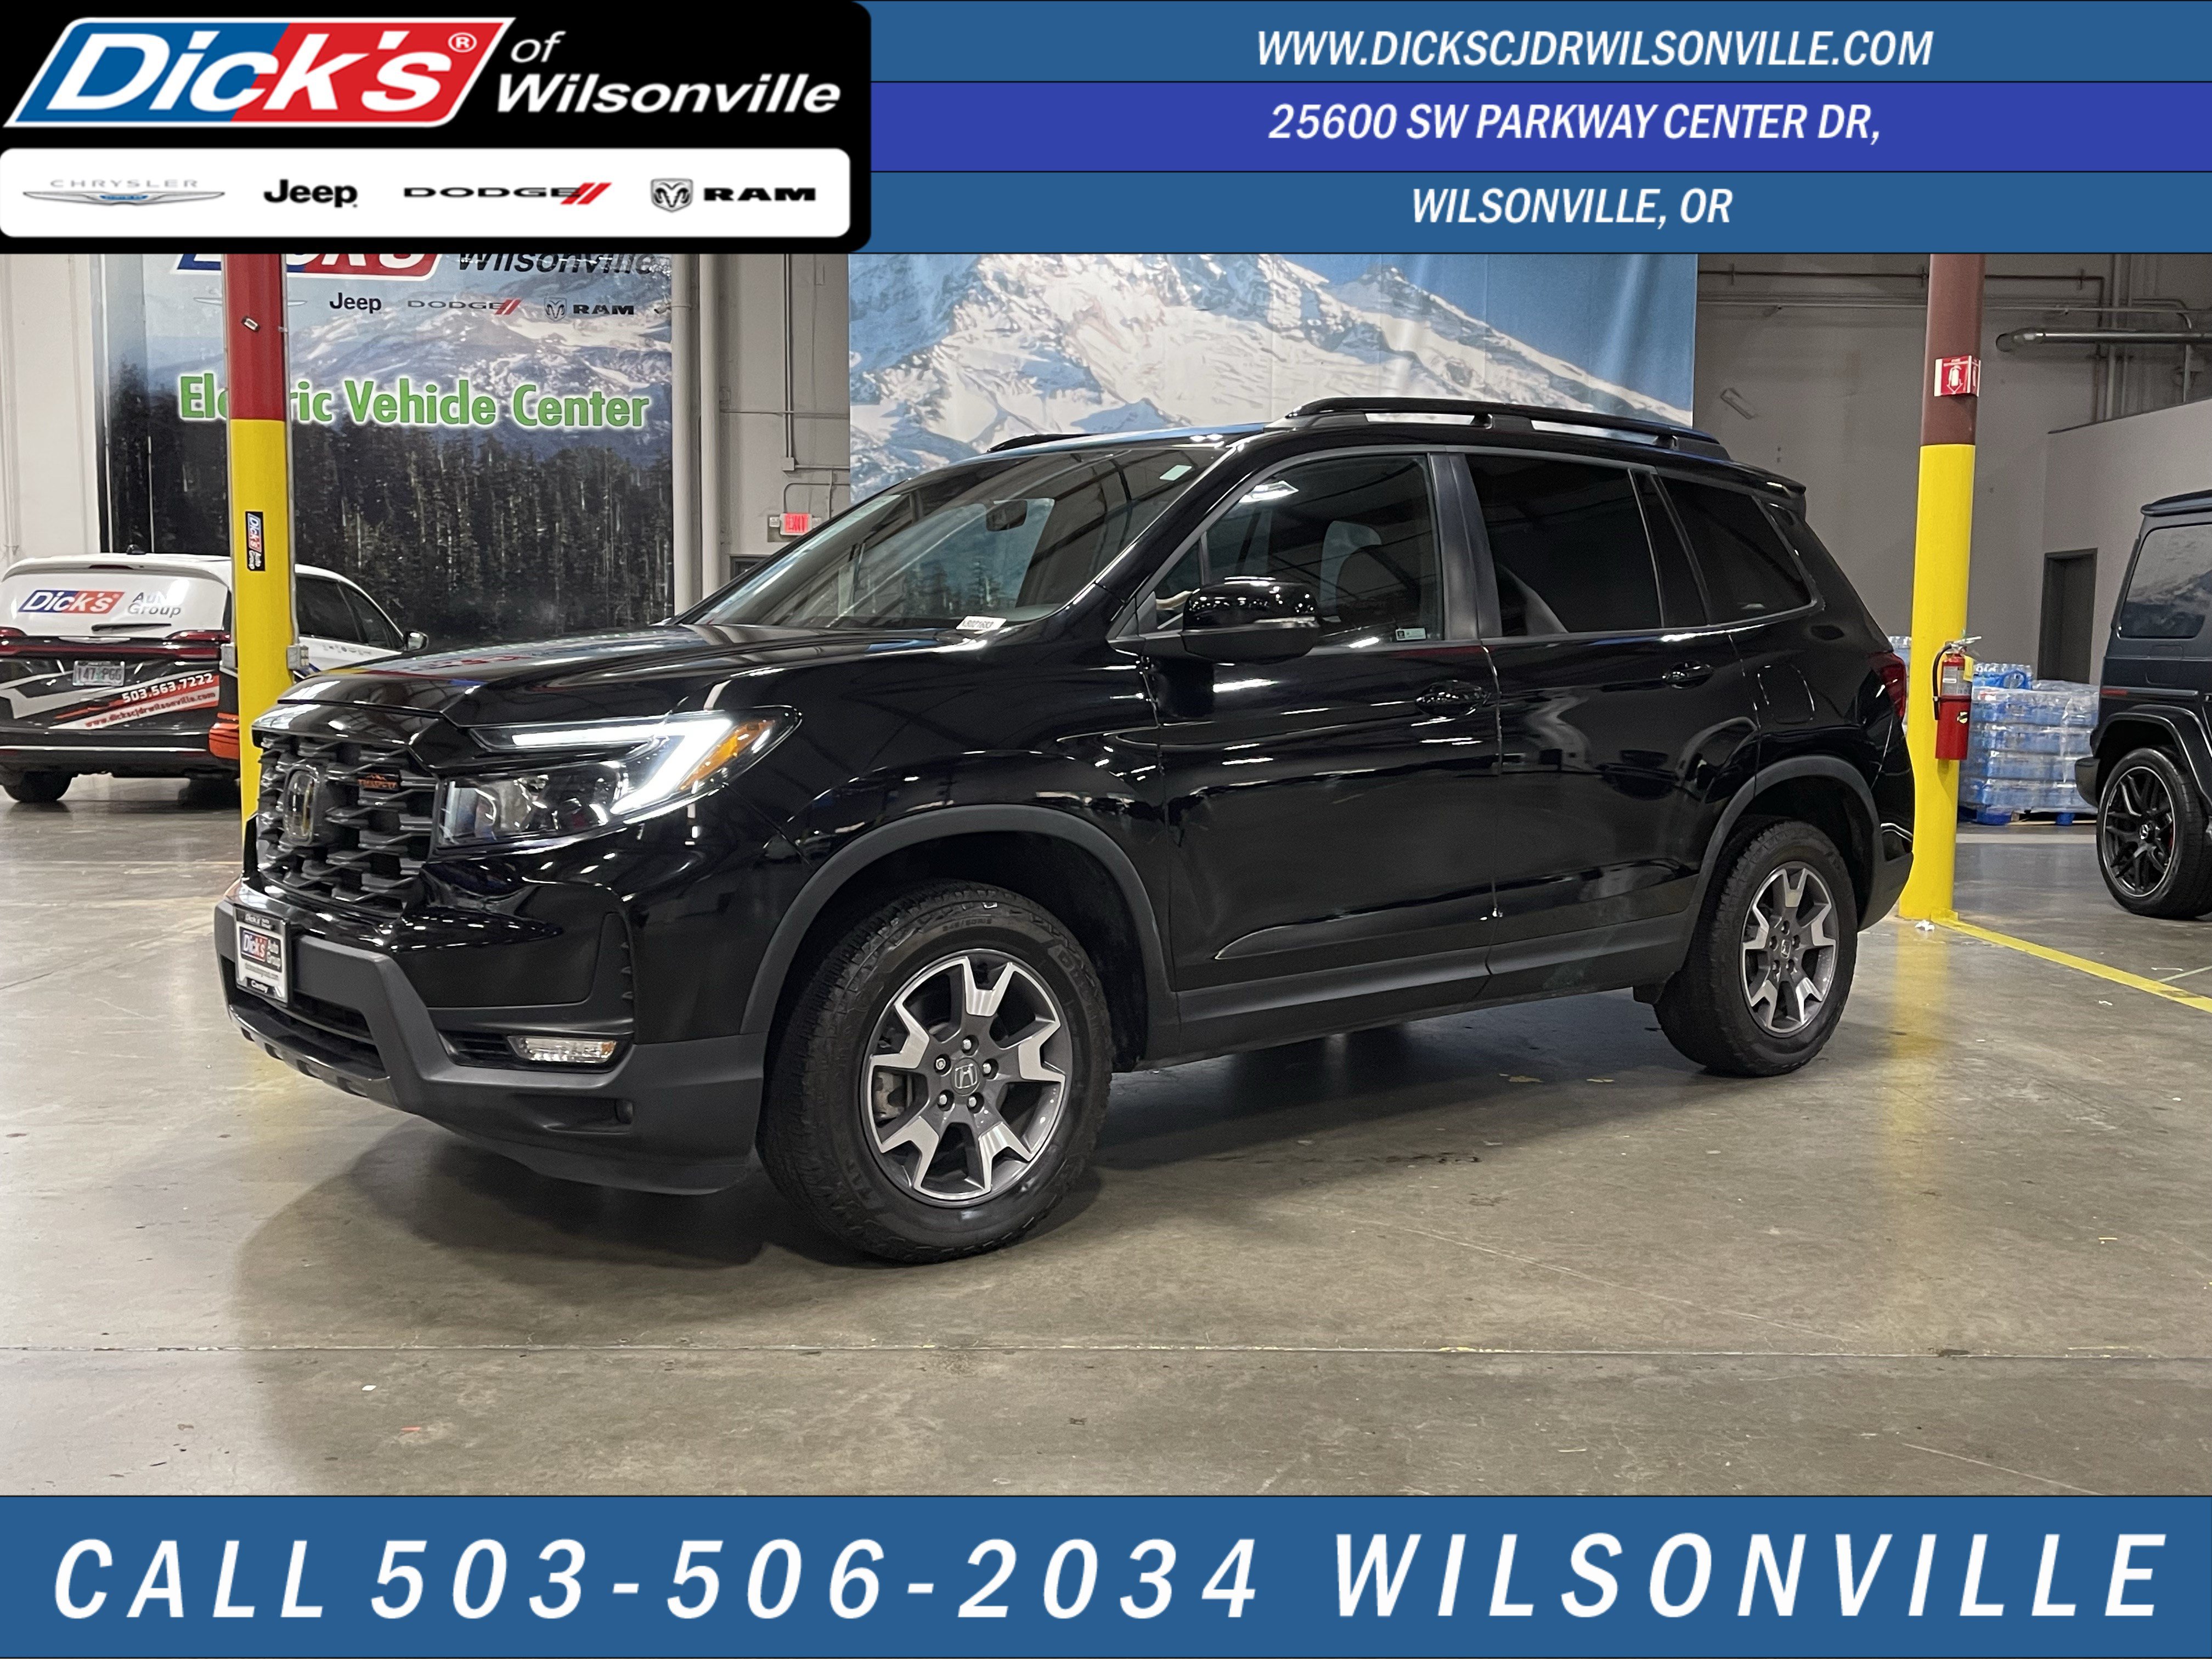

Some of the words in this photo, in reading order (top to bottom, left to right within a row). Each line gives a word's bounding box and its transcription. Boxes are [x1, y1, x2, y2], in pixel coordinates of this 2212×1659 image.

[329, 292, 382, 314] Jeep
[407, 300, 505, 310] DODGE
[573, 304, 635, 315] RAM
[344, 377, 496, 425] Vehicle
[512, 384, 650, 427] Center
[22, 591, 111, 612] Dick's
[127, 602, 182, 618] Group
[122, 673, 214, 703] 503.563.7222
